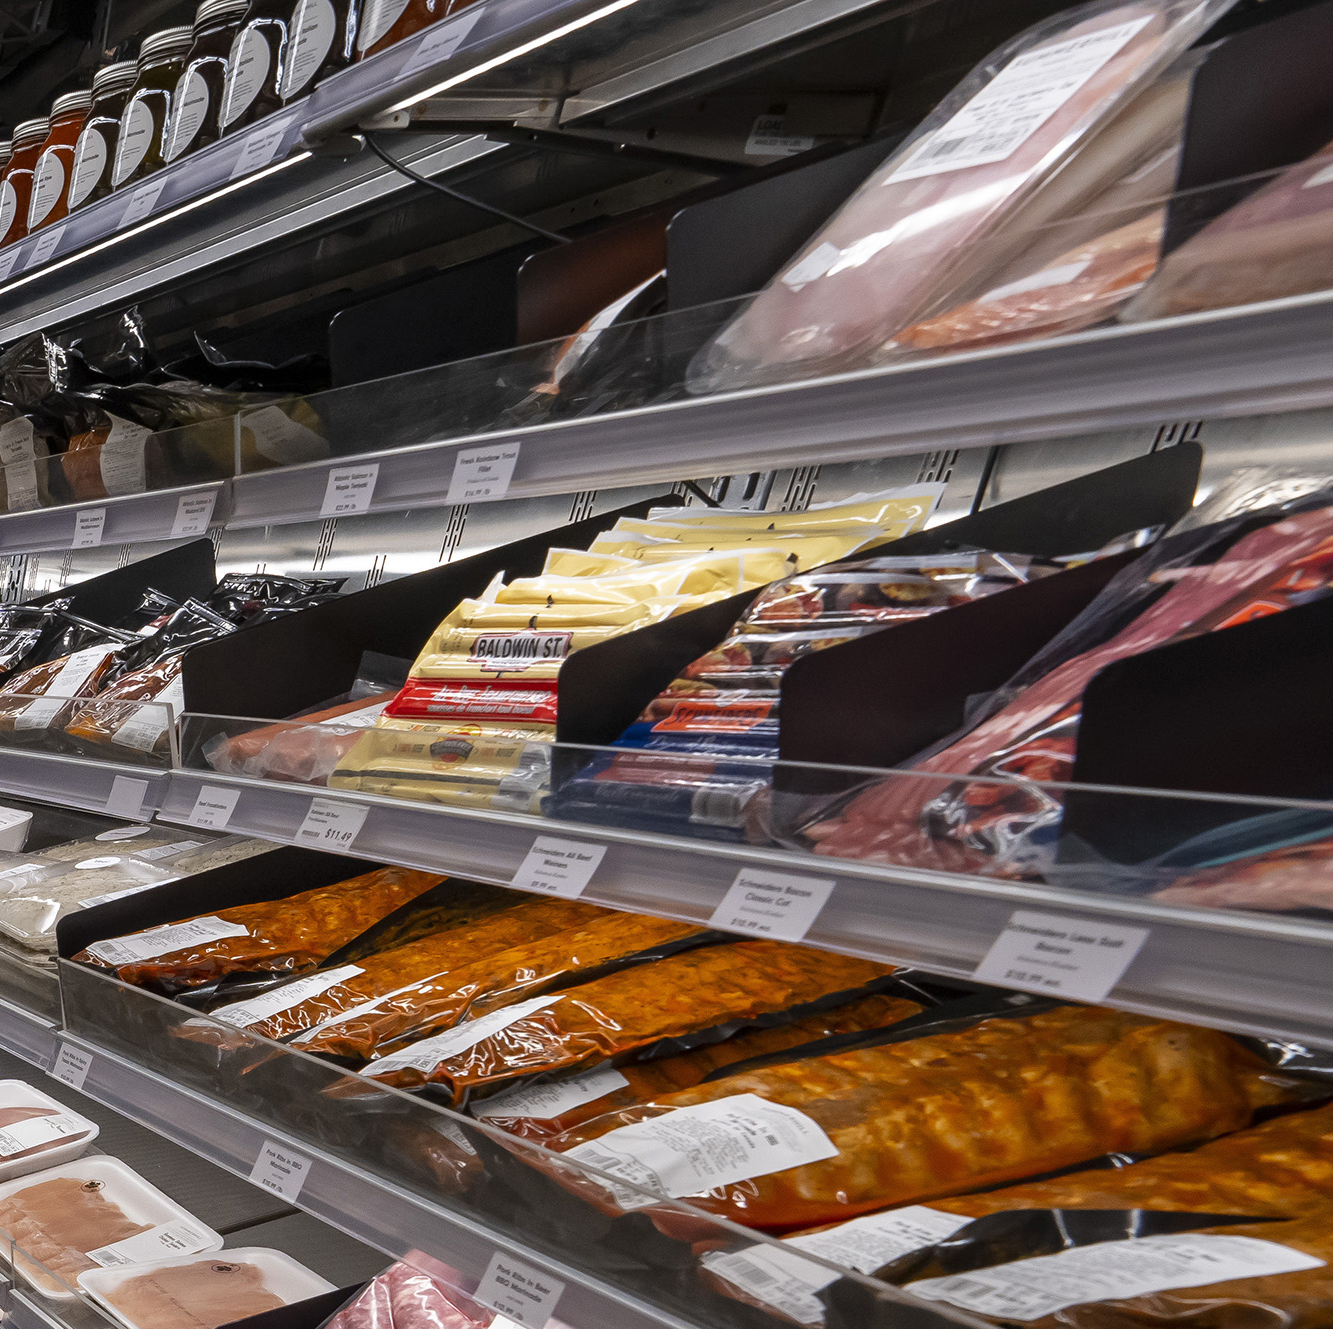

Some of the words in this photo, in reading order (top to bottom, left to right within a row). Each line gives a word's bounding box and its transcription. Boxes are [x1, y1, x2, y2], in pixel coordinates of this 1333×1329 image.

[477, 635, 540, 660] BALDWIN
[542, 635, 563, 658] ST.
[324, 829, 353, 842] $11.49
